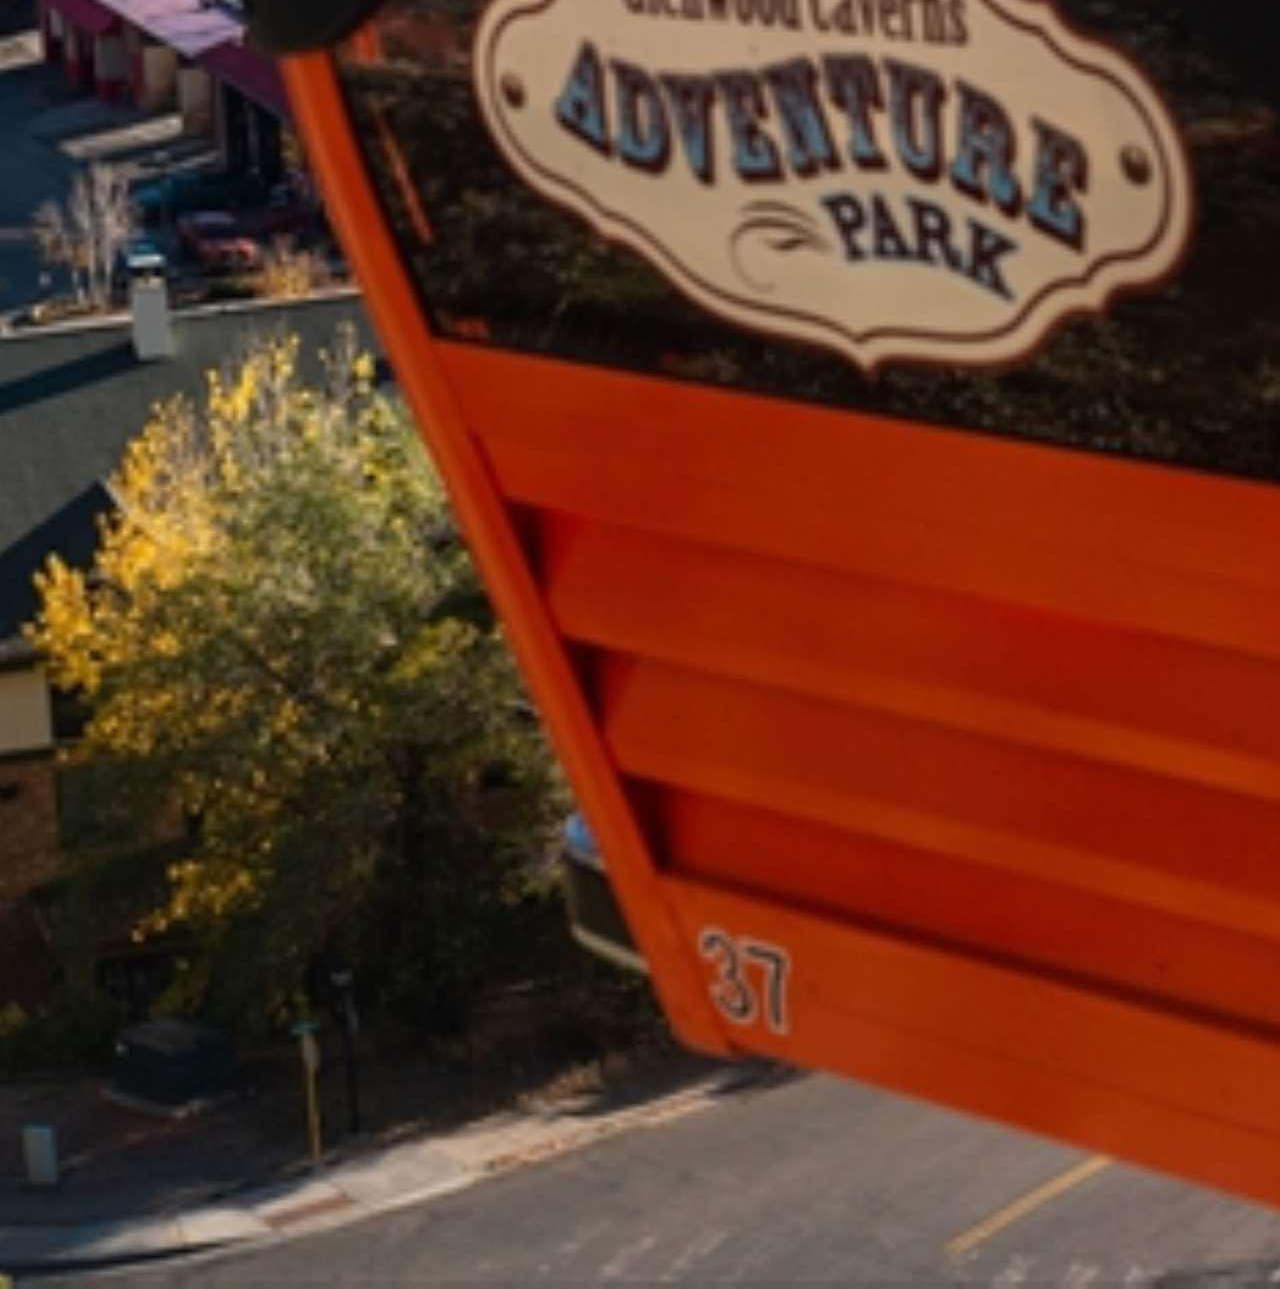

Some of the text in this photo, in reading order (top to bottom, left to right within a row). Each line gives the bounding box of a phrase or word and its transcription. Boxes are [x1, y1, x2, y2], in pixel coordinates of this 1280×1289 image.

[553, 39, 1090, 253] ADVENTURE
[822, 193, 1018, 303] PARK
[699, 927, 790, 1035] 37
